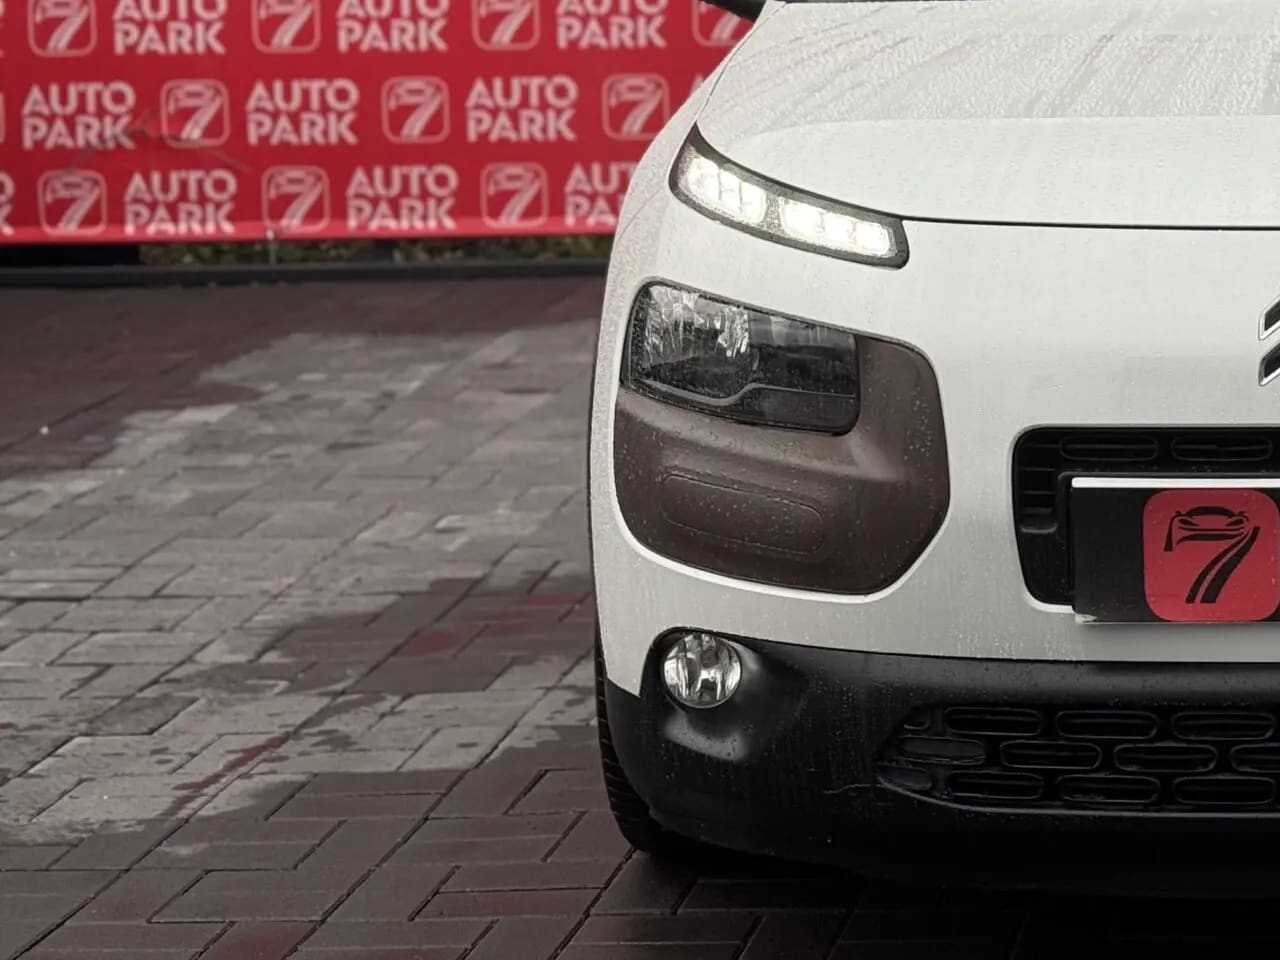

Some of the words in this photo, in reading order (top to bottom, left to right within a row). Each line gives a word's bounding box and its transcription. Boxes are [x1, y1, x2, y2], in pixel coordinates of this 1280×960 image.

[112, 20, 224, 56] PARK
[336, 18, 448, 54] PARK
[555, 15, 667, 51] PARK
[21, 80, 136, 116] AUTO
[245, 77, 360, 113] AUTO
[464, 74, 579, 110] AUTO
[21, 114, 133, 150] PARK
[245, 111, 357, 147] PARK
[464, 108, 576, 144] PARK
[123, 168, 238, 204] AUTO
[345, 163, 460, 199] AUTO
[123, 202, 235, 238] PARK
[345, 197, 457, 233] PARK
